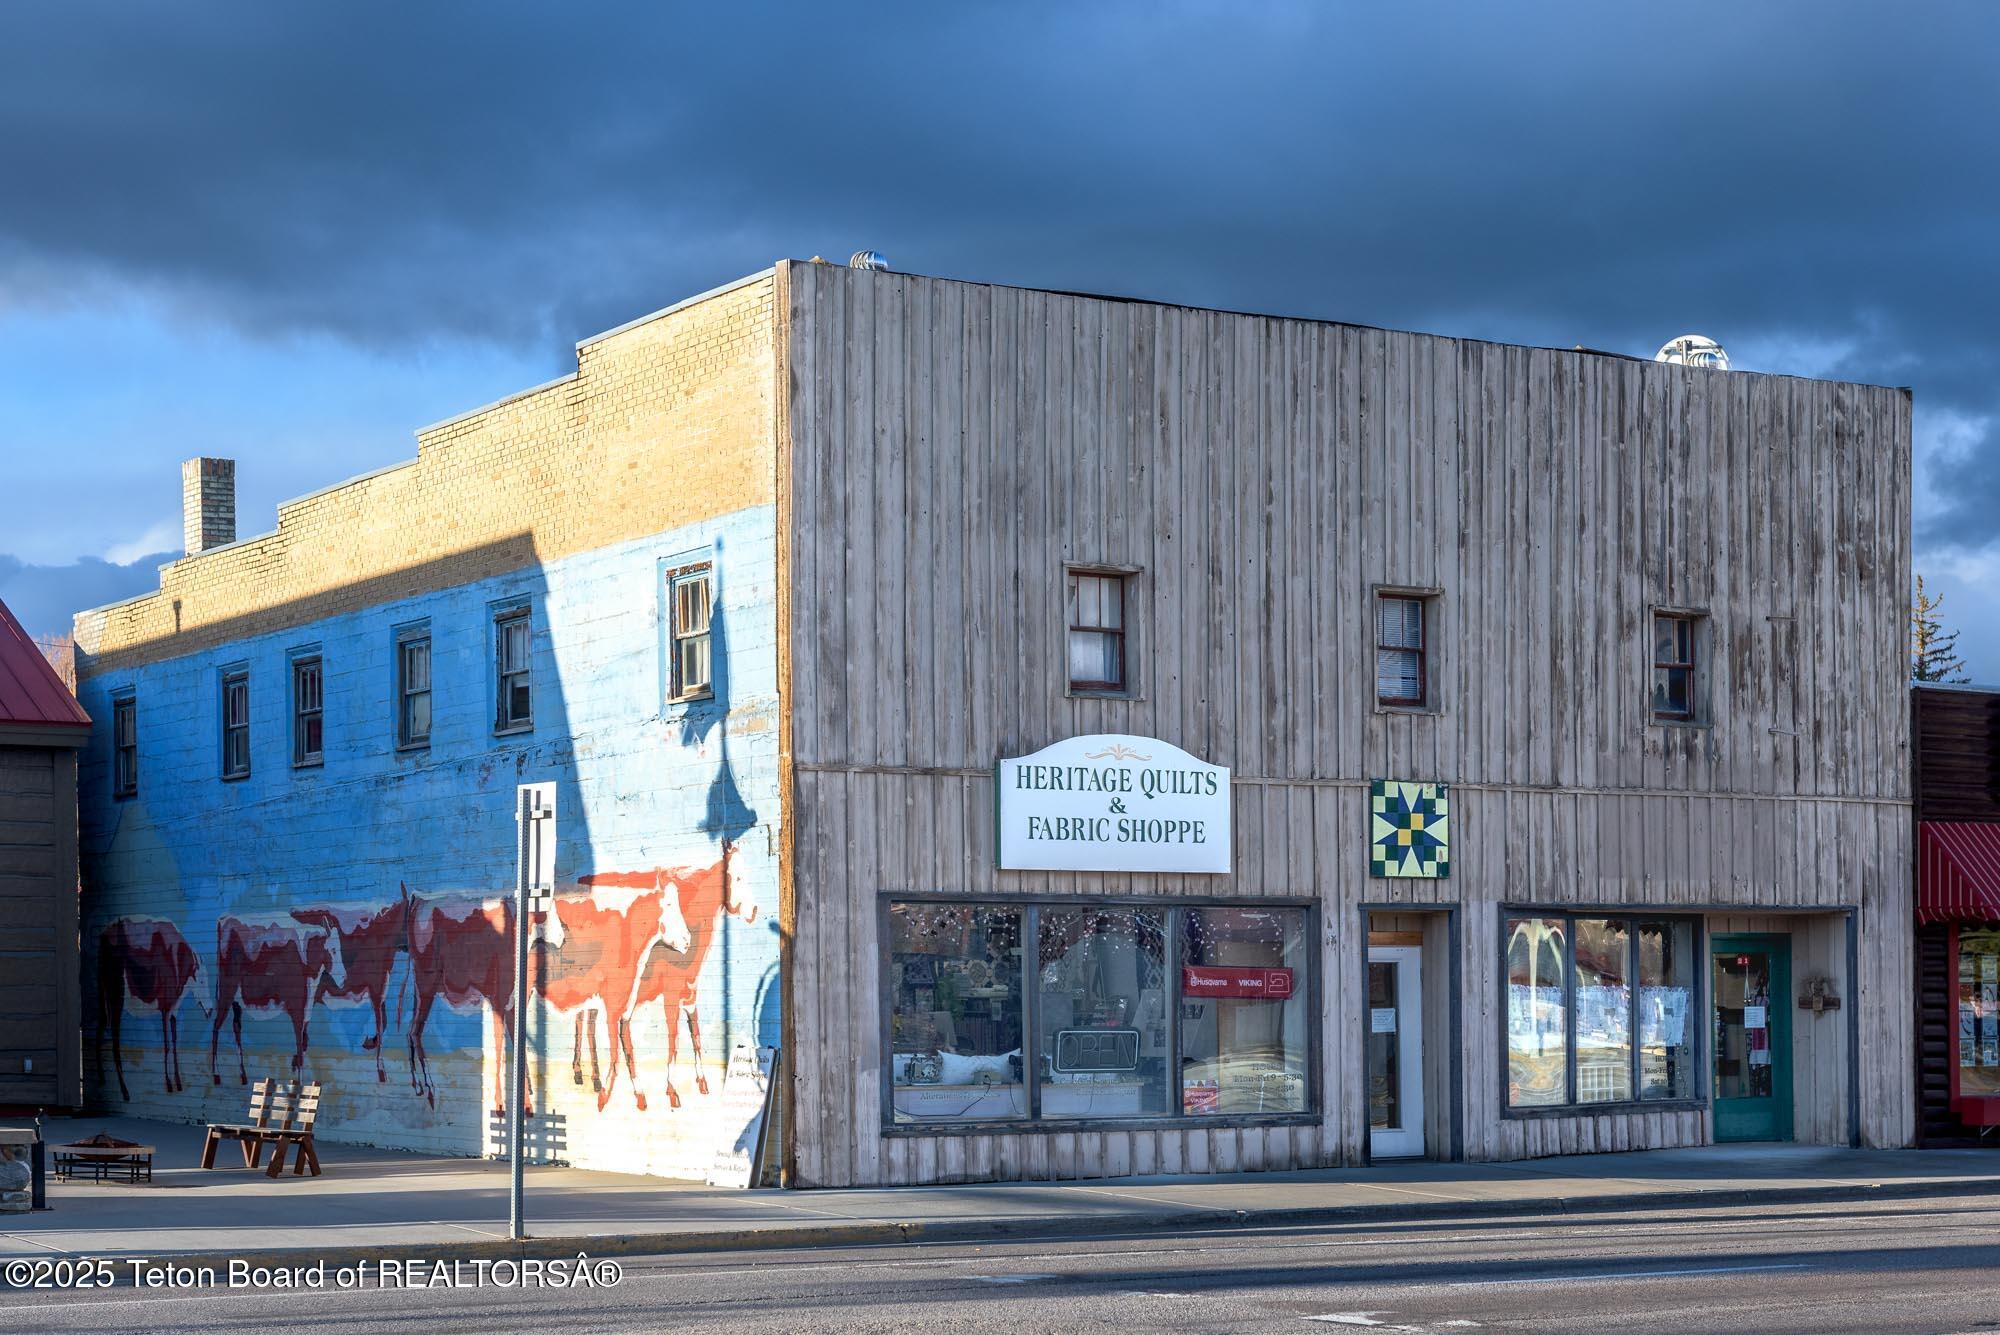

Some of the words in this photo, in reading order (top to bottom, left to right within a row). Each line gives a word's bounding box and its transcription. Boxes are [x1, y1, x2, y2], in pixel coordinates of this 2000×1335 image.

[1016, 765, 1133, 792] HERITAGE
[1140, 768, 1218, 799] QUILTS
[1108, 796, 1128, 814] &
[1028, 816, 1110, 842] FABRIC
[1117, 818, 1206, 844] SHOPPE
[1197, 978, 1228, 987] Husqvarna
[1238, 979, 1263, 987] VIKING
[1061, 1033, 1136, 1067] OPEN
